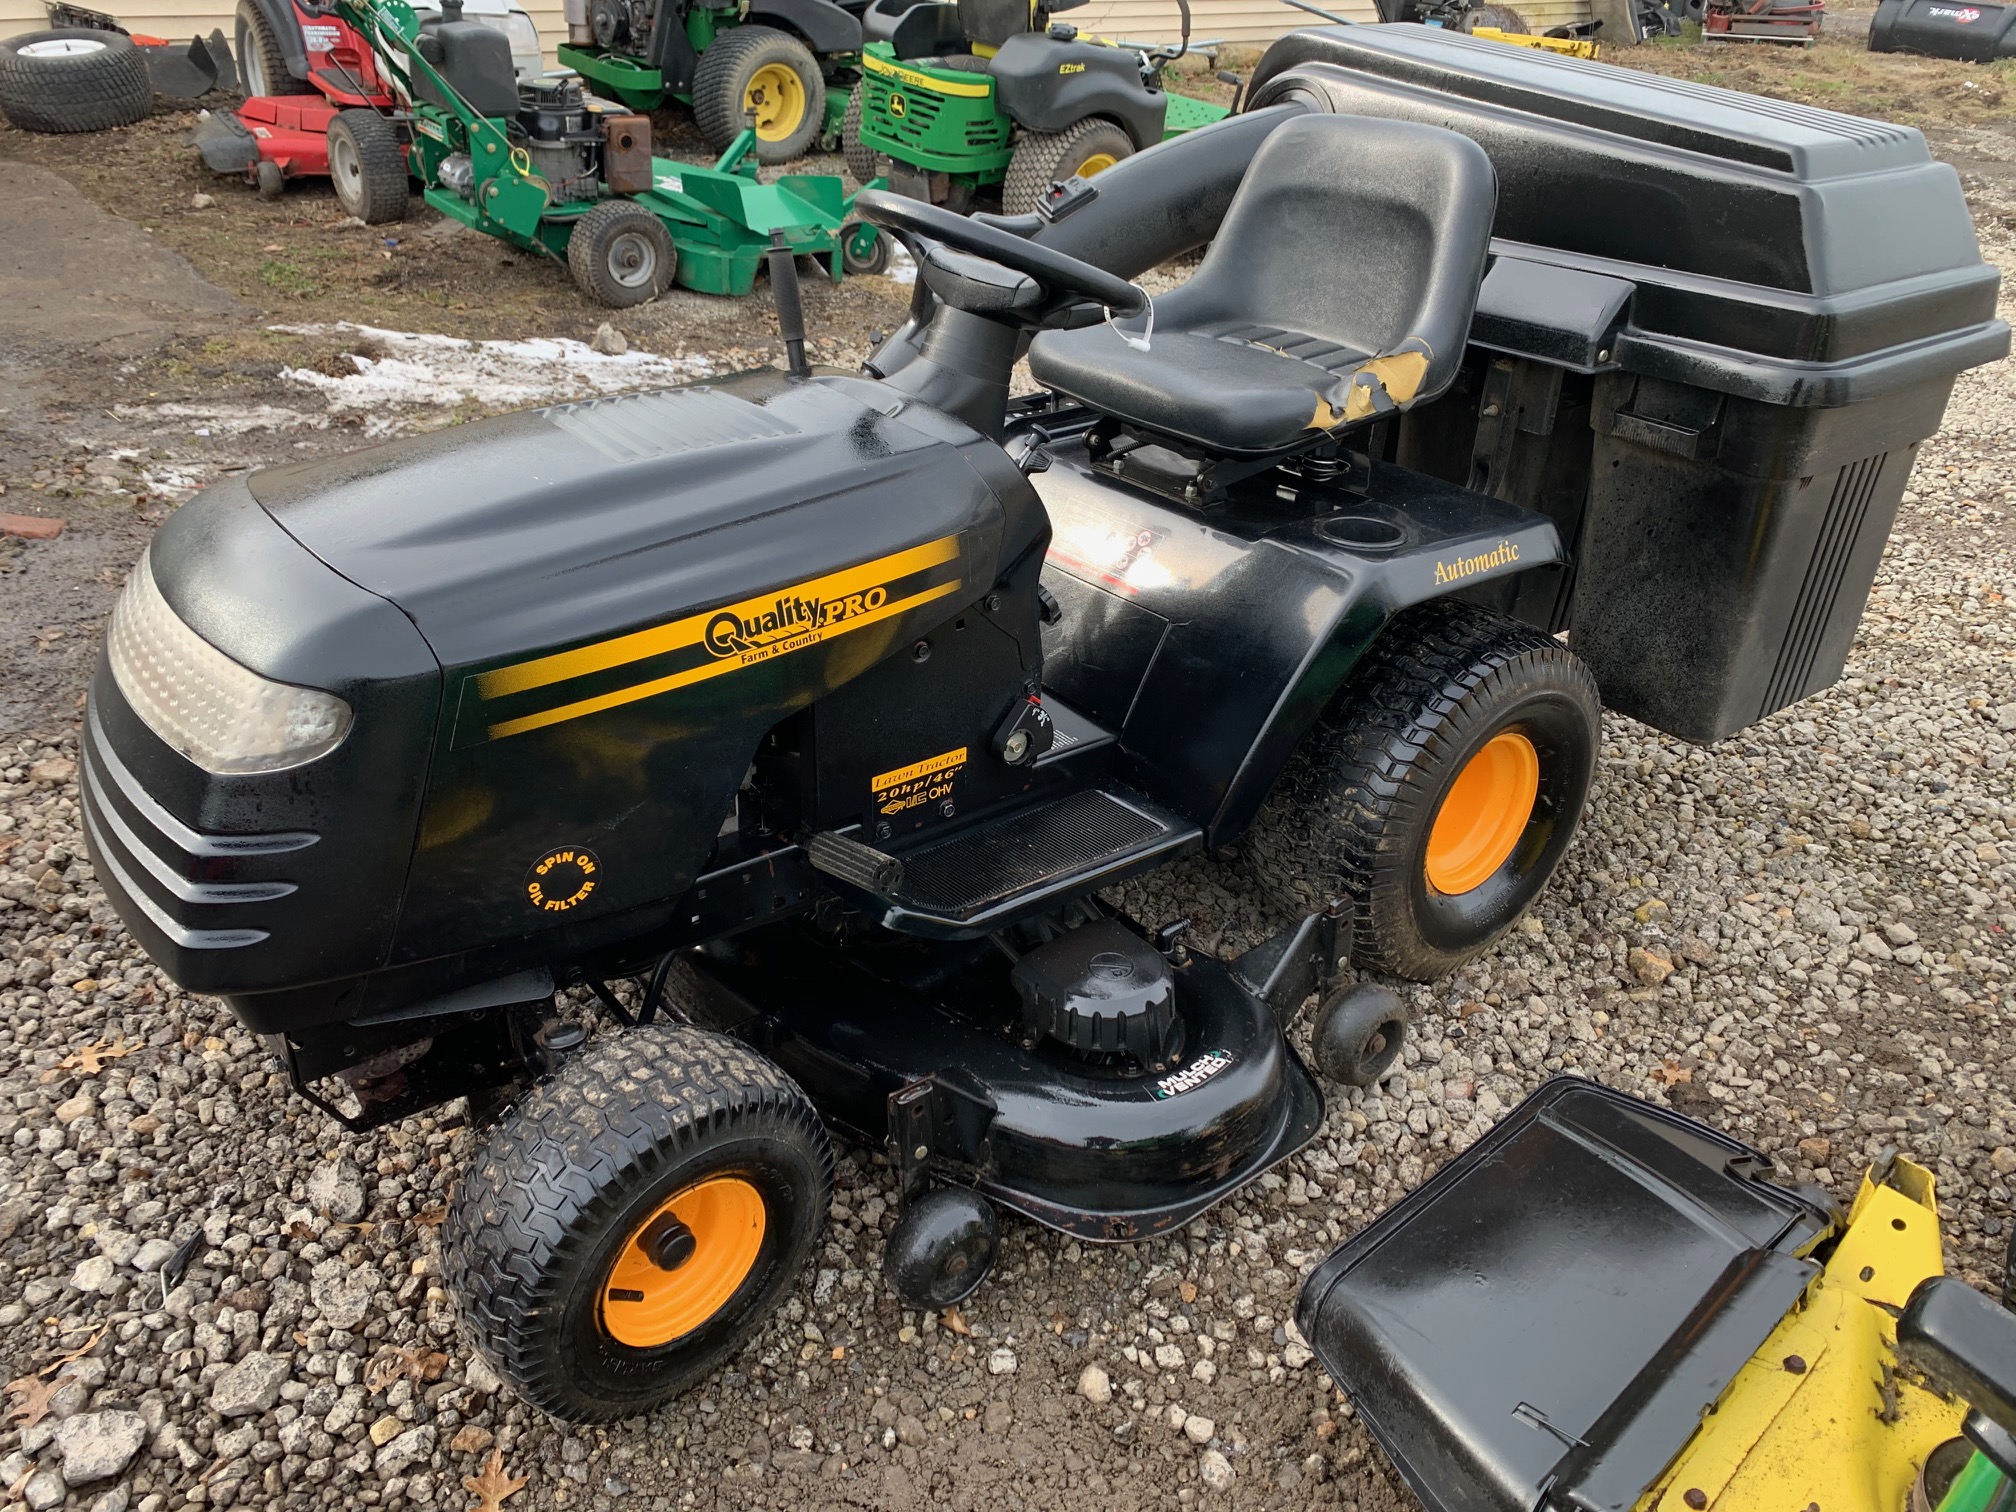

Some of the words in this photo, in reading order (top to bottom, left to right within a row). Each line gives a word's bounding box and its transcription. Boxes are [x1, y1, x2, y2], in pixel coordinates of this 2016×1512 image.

[899, 69, 925, 87] DEERE
[1059, 62, 1086, 74] EZtrak
[1434, 540, 1520, 586] Automatic
[705, 596, 821, 658] Quality
[822, 587, 887, 626] PRO
[741, 649, 769, 665] Farm
[771, 645, 780, 655] &
[782, 631, 824, 651] Country
[875, 769, 914, 789] Lawn
[918, 752, 965, 774] Tractor
[928, 781, 953, 800] OHV
[536, 851, 574, 876] SPIN
[576, 855, 596, 875] ON
[528, 882, 544, 907] OIL
[544, 881, 596, 911] FILTER
[1157, 1054, 1214, 1089] MULCH
[1162, 1057, 1227, 1096] VENTED
